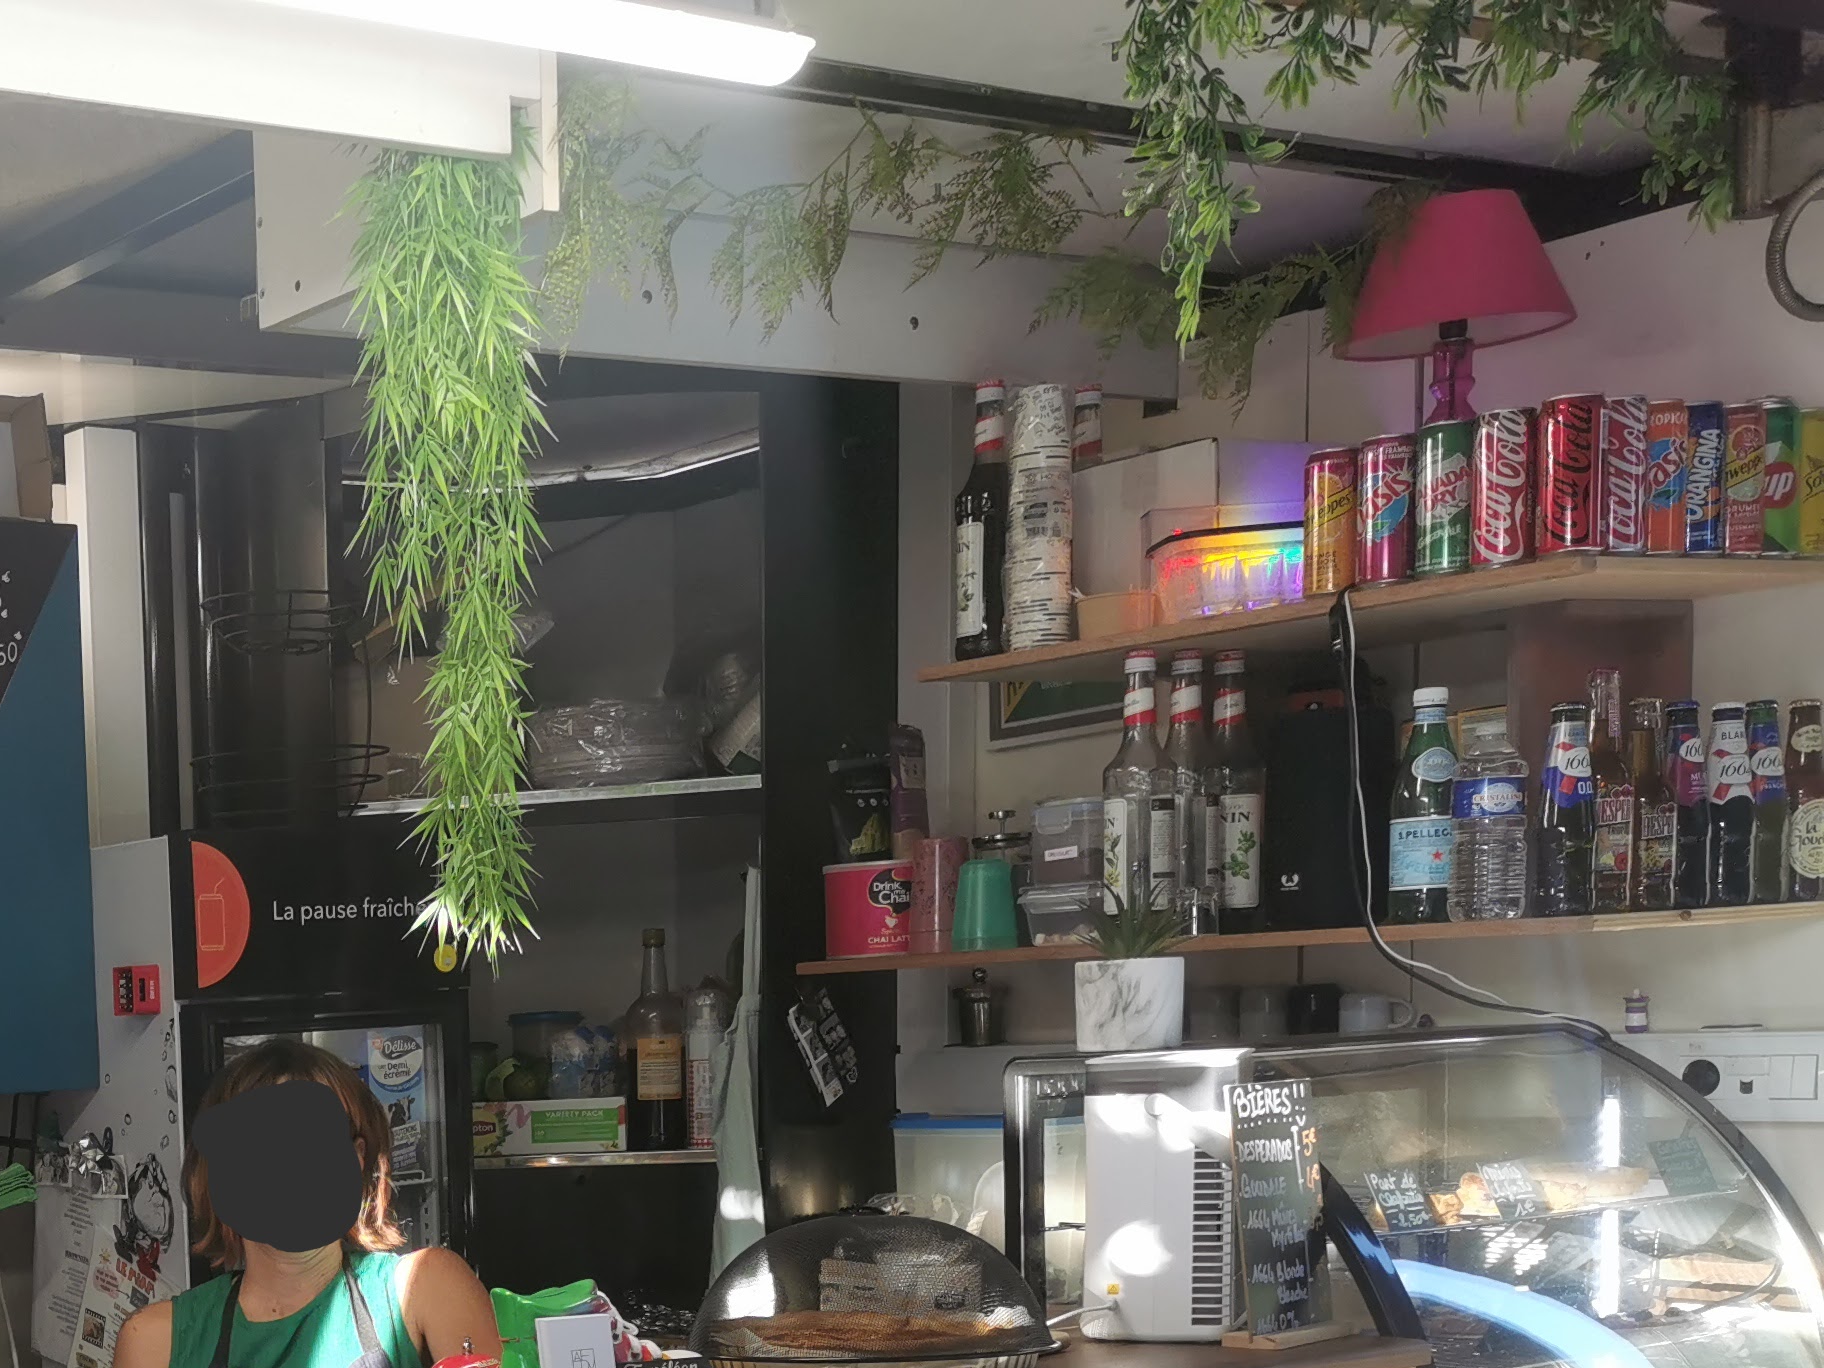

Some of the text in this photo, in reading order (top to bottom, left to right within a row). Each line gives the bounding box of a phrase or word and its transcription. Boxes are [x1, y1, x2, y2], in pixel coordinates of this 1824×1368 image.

[1686, 429, 1720, 521] ORANGINA
[873, 882, 902, 891] Drink
[878, 891, 910, 904] Chai
[272, 901, 295, 922] La
[300, 901, 358, 926] pause
[384, 1040, 417, 1054] Délisse
[387, 1060, 408, 1070] Demi
[1236, 1140, 1293, 1164] DESPERADOS
